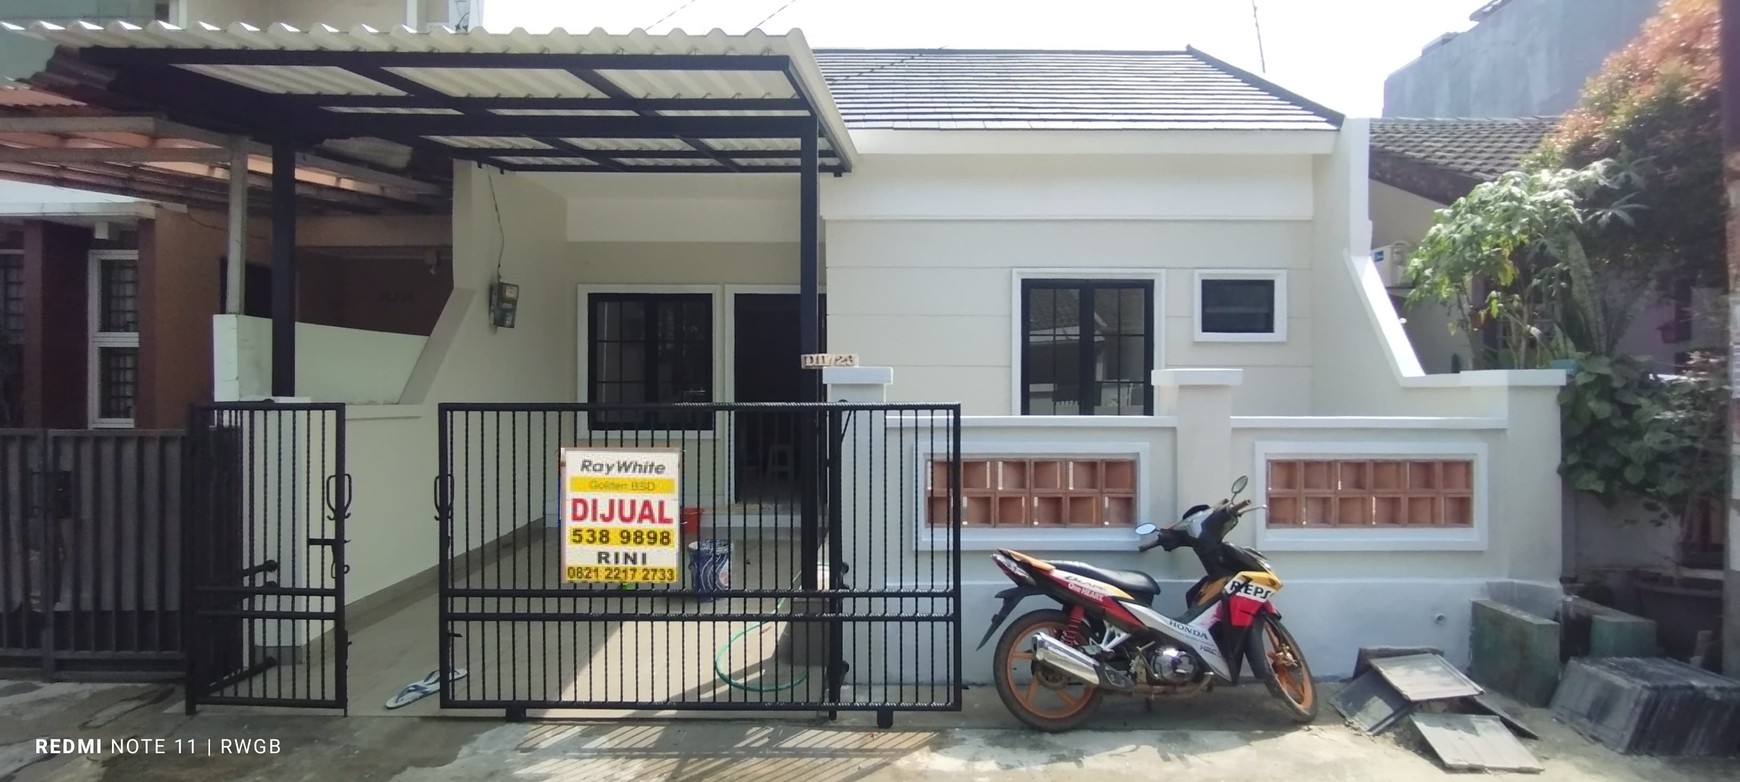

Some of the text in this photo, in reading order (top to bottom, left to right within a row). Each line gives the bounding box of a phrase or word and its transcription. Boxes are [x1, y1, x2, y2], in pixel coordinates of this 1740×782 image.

[589, 480, 655, 491] Golden BSD
[570, 498, 674, 525] DIJUAL
[572, 529, 671, 545] 538 9898
[597, 551, 647, 565] RINI
[567, 567, 675, 581] 0821 2217 2733
[1067, 582, 1082, 593] One
[1169, 620, 1209, 640] HONDA
